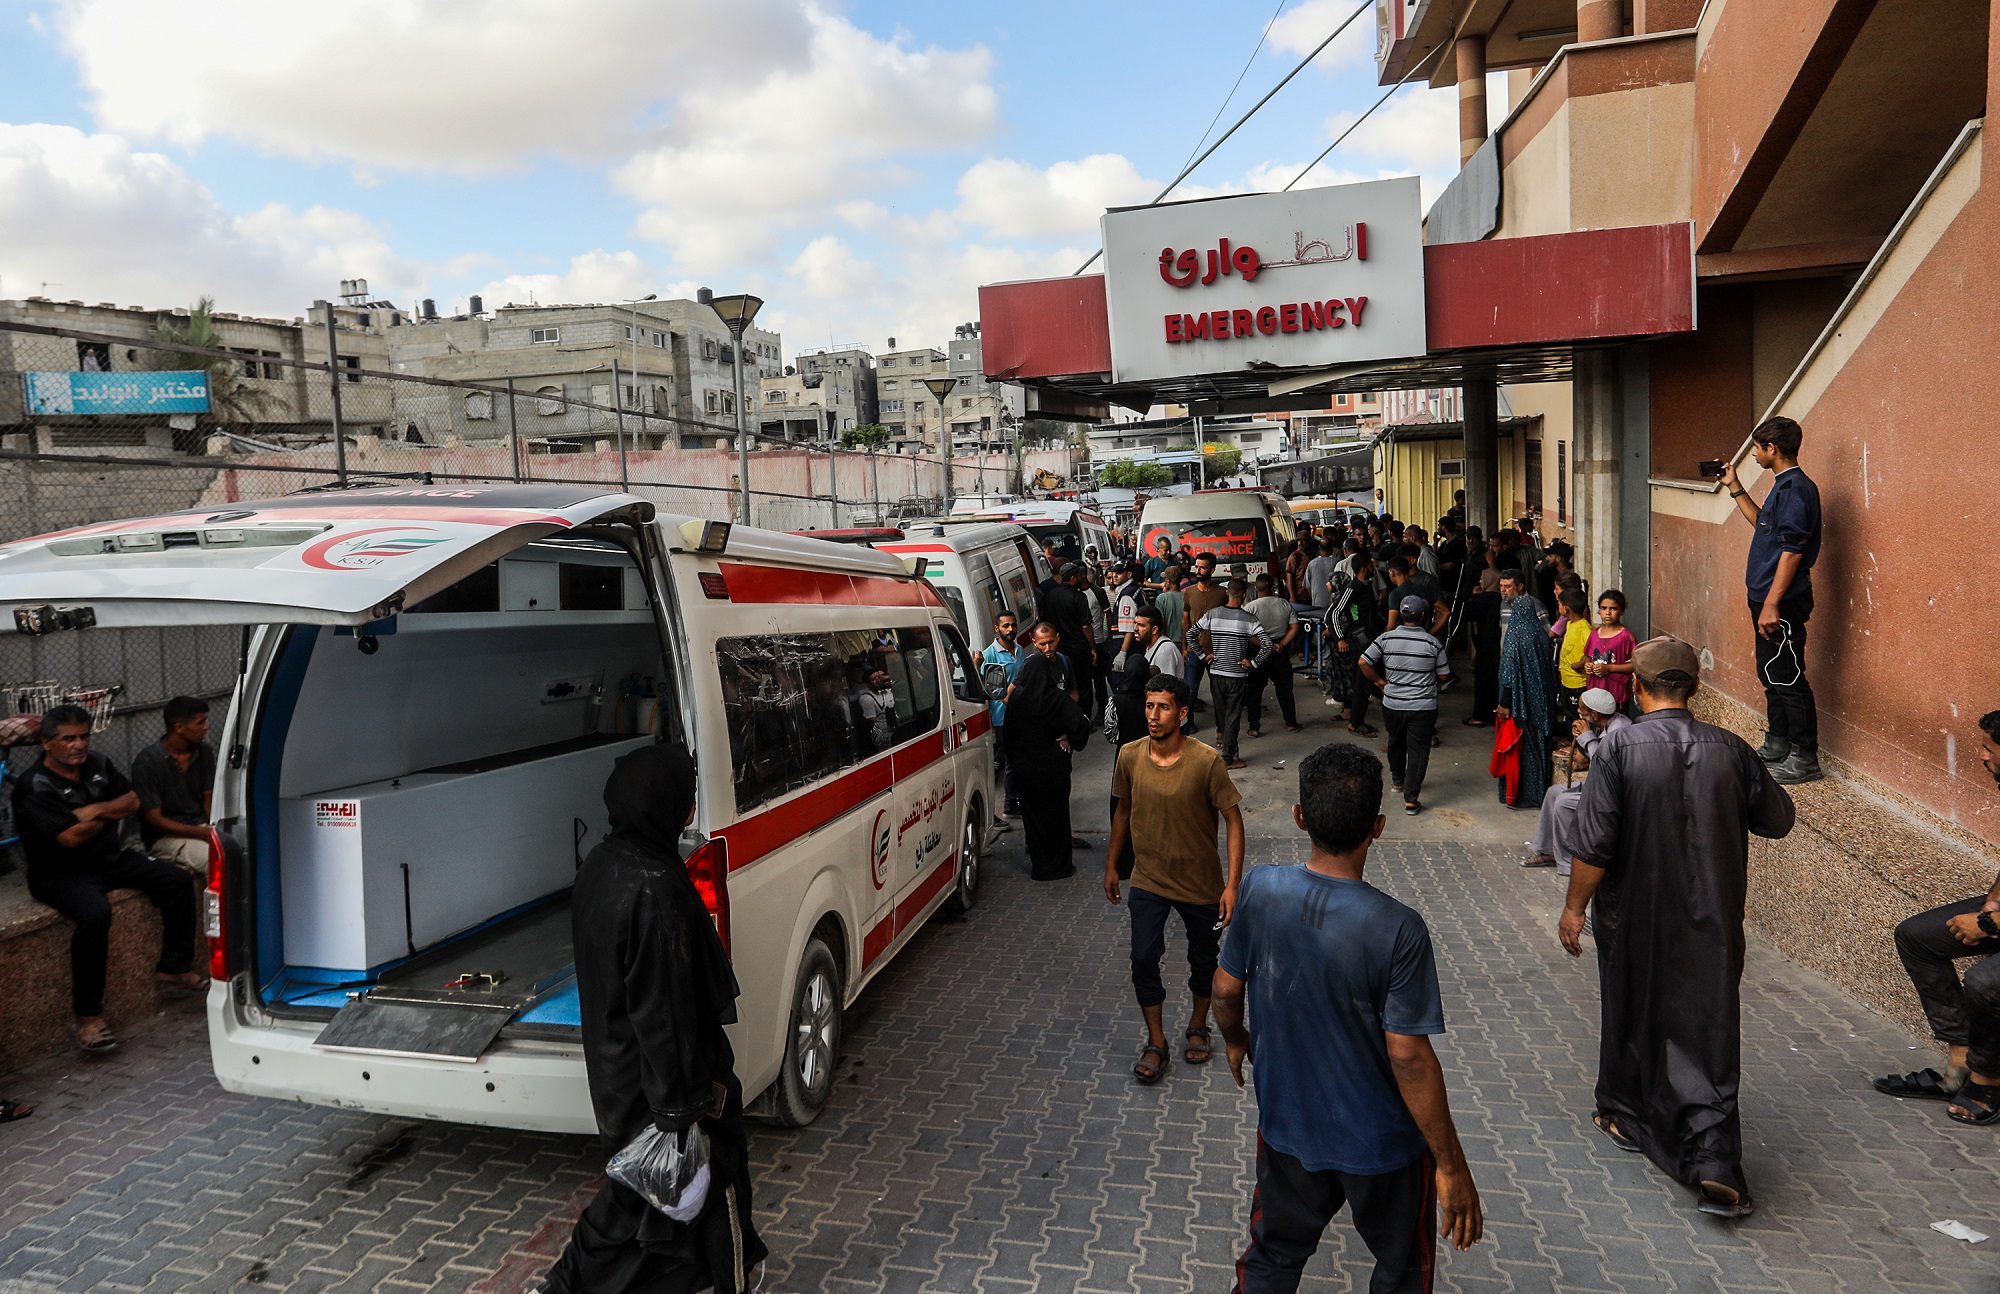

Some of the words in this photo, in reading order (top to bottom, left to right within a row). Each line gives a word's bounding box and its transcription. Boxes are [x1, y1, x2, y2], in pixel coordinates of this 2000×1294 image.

[1159, 222, 1367, 287] الطوارئ
[1165, 297, 1368, 343] EMERGENCY
[73, 383, 139, 404] الوليد
[147, 381, 206, 404] مختبر
